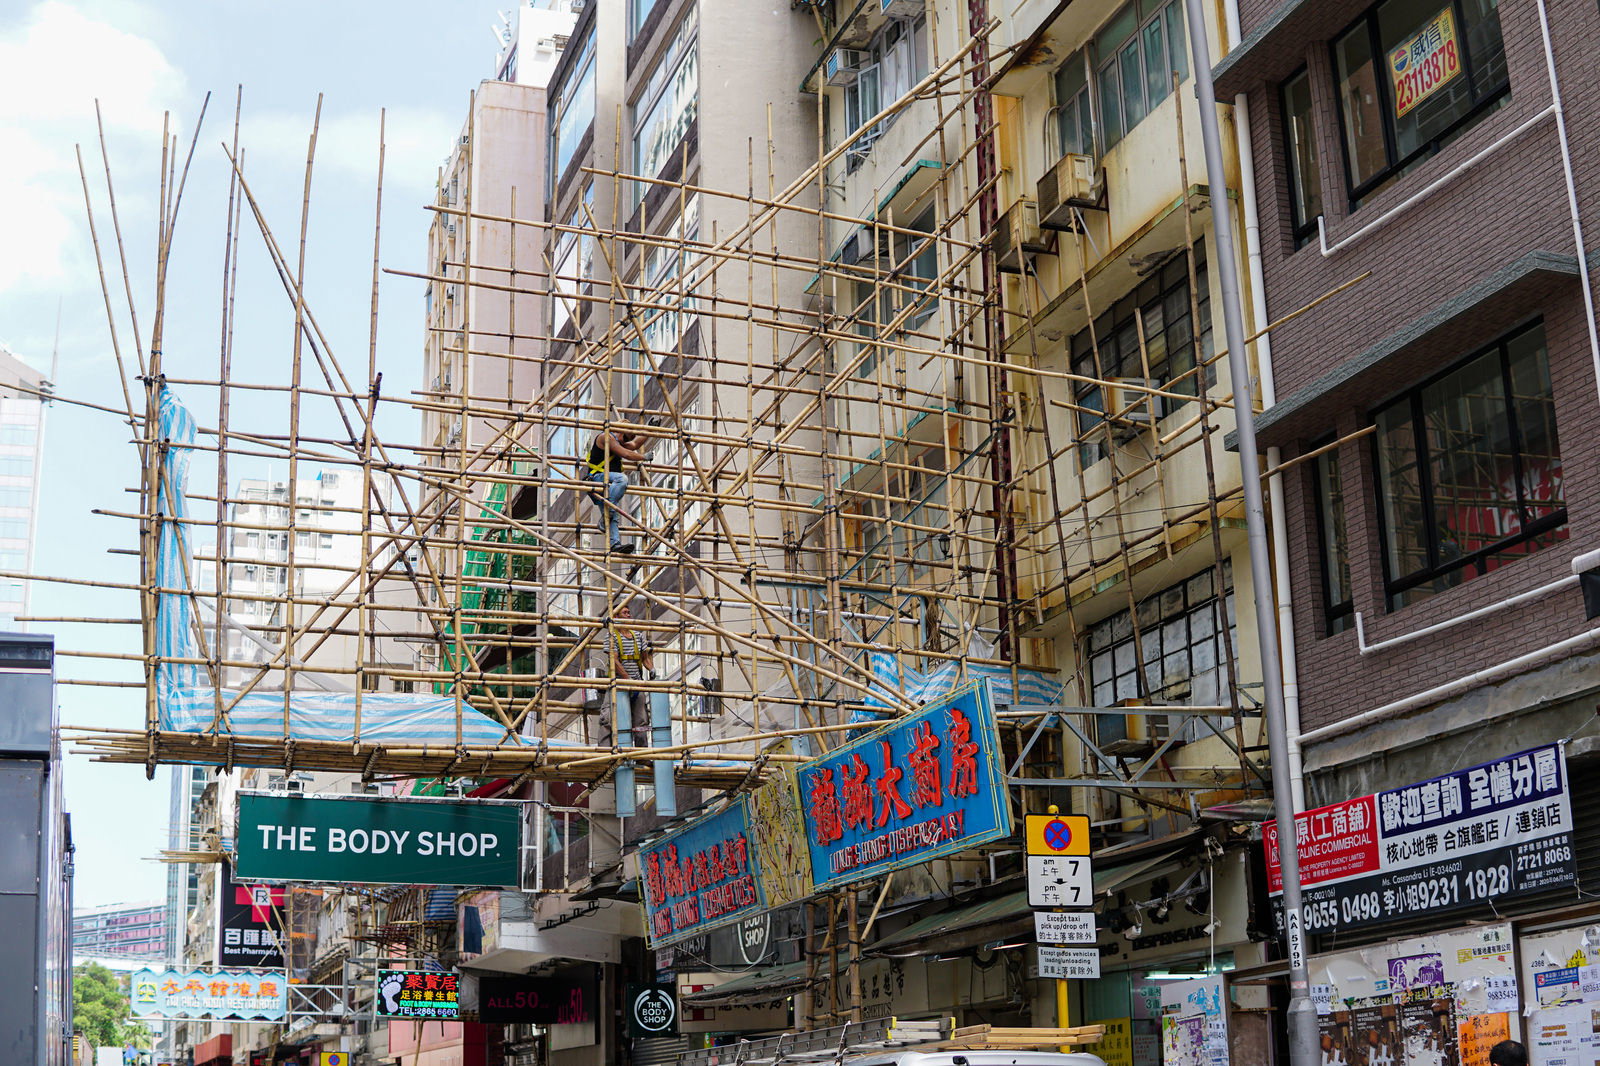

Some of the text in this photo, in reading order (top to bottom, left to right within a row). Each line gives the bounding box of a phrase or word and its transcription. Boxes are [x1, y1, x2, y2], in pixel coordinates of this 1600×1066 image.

[1411, 22, 1441, 62] 威信
[1397, 40, 1456, 110] 23113878
[1381, 750, 1559, 832] 歡迎查詢 全幢分層
[1295, 801, 1370, 846] 原(工商舖)
[257, 825, 316, 852] THE
[328, 828, 410, 855] BODY
[1386, 834, 1438, 864] 核心地帶
[1443, 819, 1500, 852] 合旗艦店
[1515, 803, 1561, 834] 連鎖店
[1322, 833, 1373, 854] COMMERCIAL
[1517, 846, 1571, 871] 2721 8068
[1041, 867, 1059, 876] 上午
[1068, 860, 1079, 876] 7
[1392, 871, 1422, 884] Cassandra
[1429, 860, 1463, 877] (E-034602)
[1042, 894, 1060, 902] 下午
[1070, 887, 1081, 902] 7
[1303, 899, 1338, 931] 9655
[1342, 891, 1380, 923] 0498
[1465, 864, 1510, 902] 1828
[1047, 914, 1067, 923] Except
[224, 928, 284, 946] 百匯藥
[745, 927, 764, 947] SHOP
[1039, 931, 1092, 940] 的士上落客除外
[224, 946, 241, 954] Best
[242, 947, 277, 956] Pharmacy
[1072, 949, 1096, 957] vehicles
[405, 974, 457, 991] 聚賢居
[487, 991, 539, 1009] ALL 50
[647, 1001, 661, 1009] THE
[642, 1008, 667, 1016] BODY
[643, 1015, 666, 1023] SHOP
